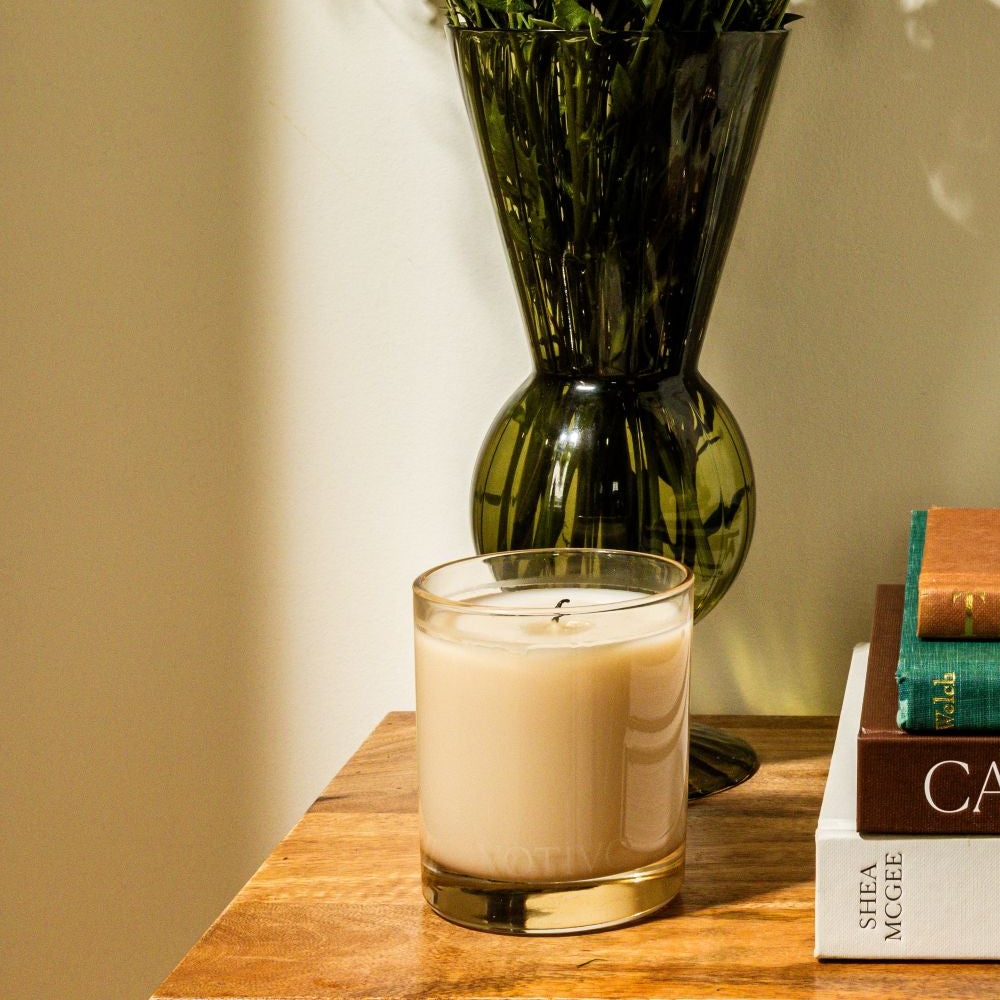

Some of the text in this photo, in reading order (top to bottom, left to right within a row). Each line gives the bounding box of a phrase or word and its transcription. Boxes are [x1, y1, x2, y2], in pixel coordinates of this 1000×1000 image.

[932, 671, 956, 730] Welch
[858, 862, 878, 930] SHEA
[884, 851, 903, 942] MCGEE
